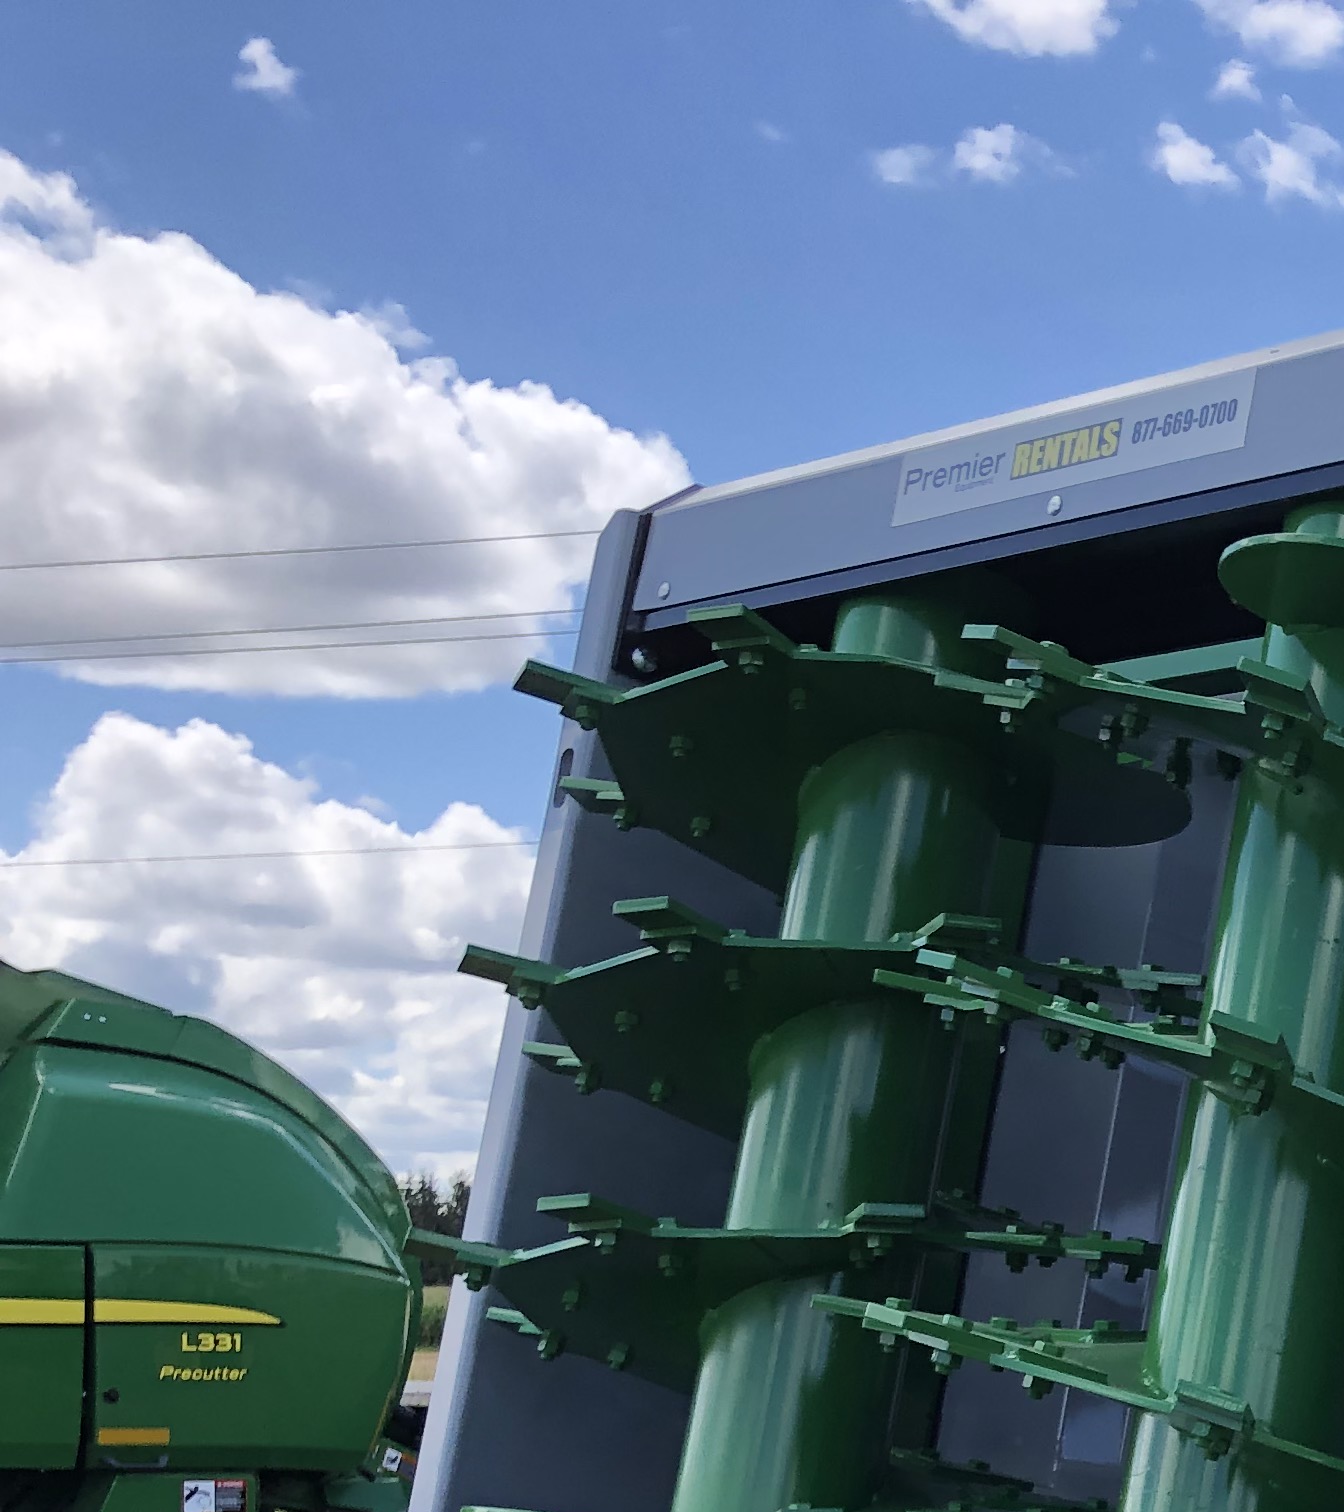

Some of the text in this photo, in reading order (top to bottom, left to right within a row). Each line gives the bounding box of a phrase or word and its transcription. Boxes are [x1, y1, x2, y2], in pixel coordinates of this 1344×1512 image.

[903, 398, 1238, 495] Premier RENTALS 877-669-0700
[181, 1331, 242, 1353] L331
[159, 1365, 248, 1381] Precutter
